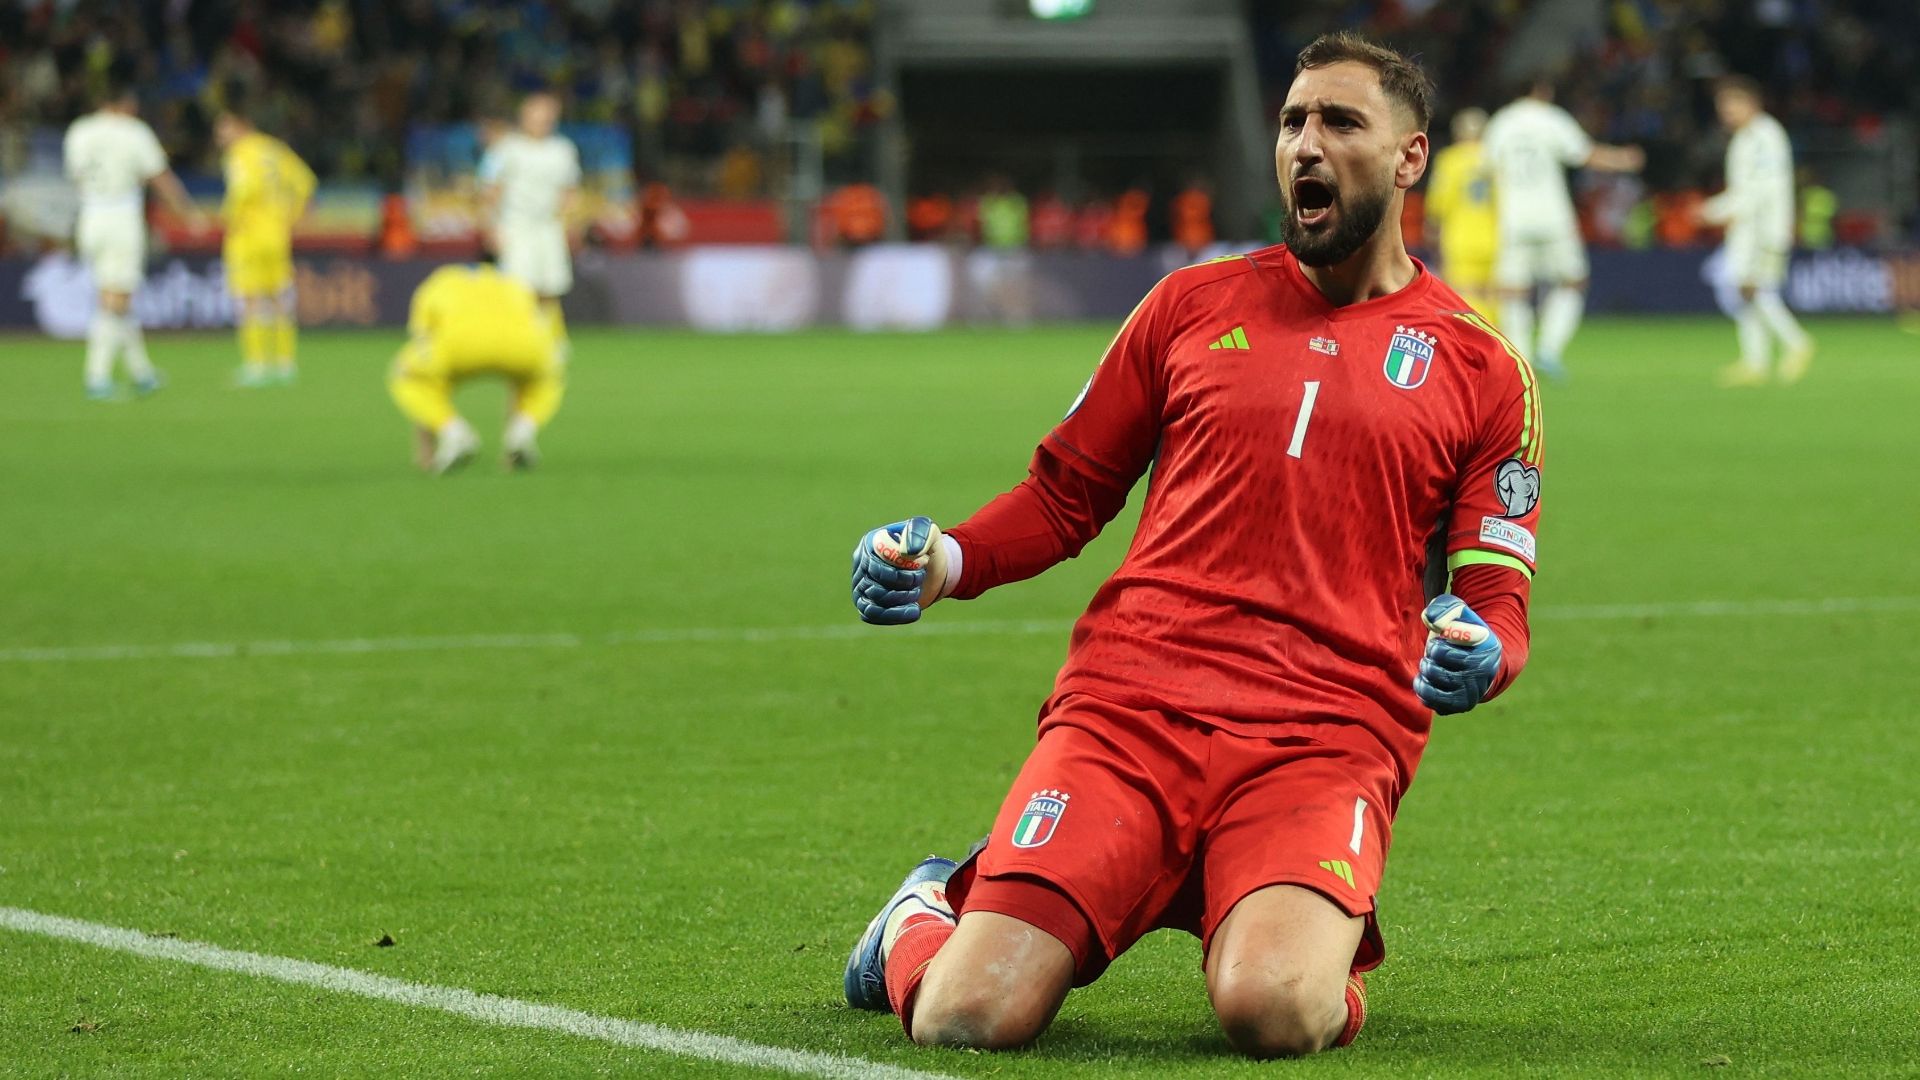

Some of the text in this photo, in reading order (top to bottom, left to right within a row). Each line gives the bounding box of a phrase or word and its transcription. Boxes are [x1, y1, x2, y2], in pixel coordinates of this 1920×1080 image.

[1395, 336, 1429, 358] ITALIA
[1286, 381, 1320, 459] 1
[1484, 518, 1501, 526] UEFA
[877, 541, 920, 570] adidas
[1440, 627, 1472, 642] das
[1025, 801, 1059, 815] ITALIA
[1349, 795, 1368, 856] 1
